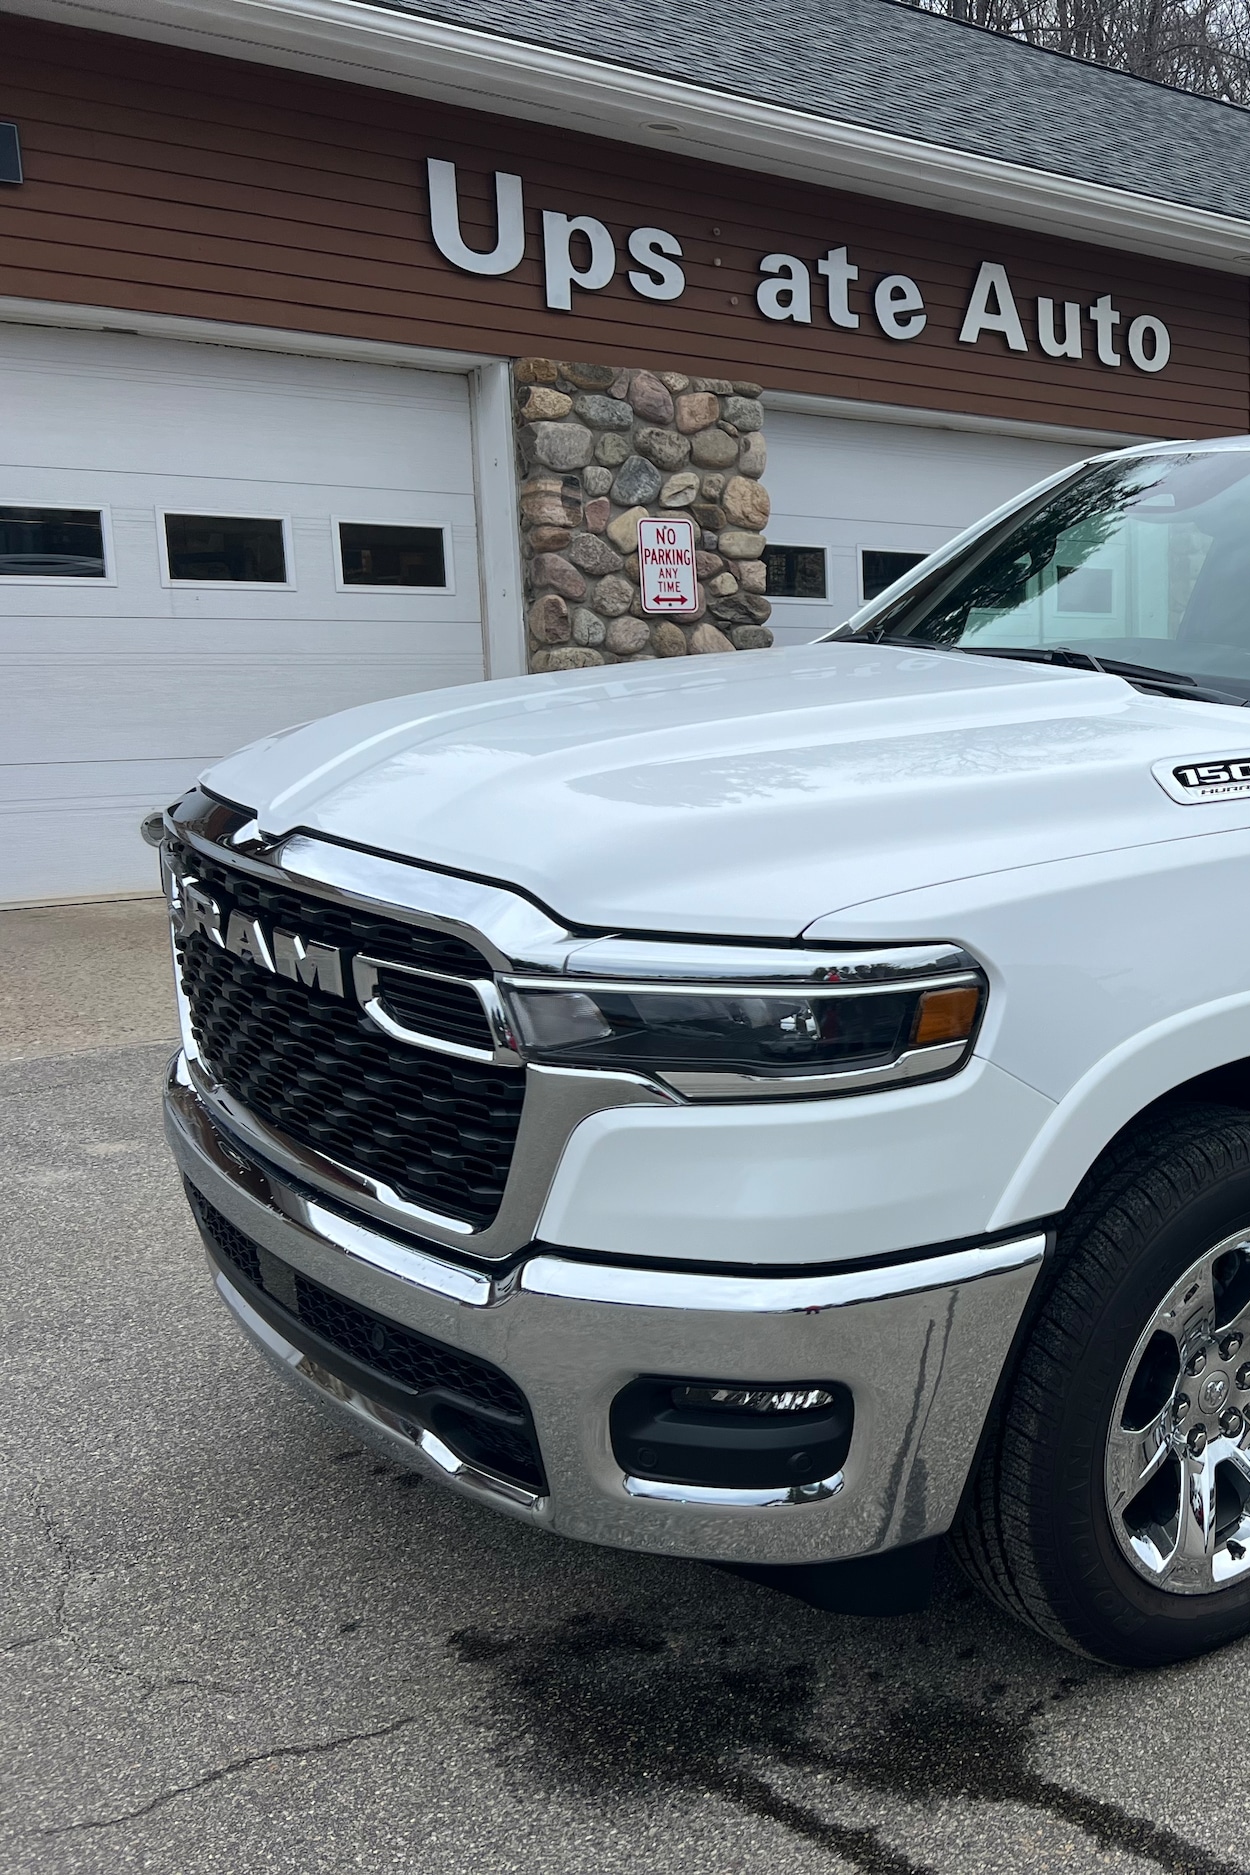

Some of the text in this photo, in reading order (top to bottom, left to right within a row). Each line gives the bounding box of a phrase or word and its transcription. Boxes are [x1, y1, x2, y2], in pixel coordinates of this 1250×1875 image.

[425, 156, 687, 312] Ups
[958, 260, 1173, 374] Auto
[655, 528, 676, 545] NO
[644, 548, 691, 566] PARKING
[658, 568, 679, 579] ANY
[657, 581, 682, 593] TIME
[180, 883, 345, 999] RAM
